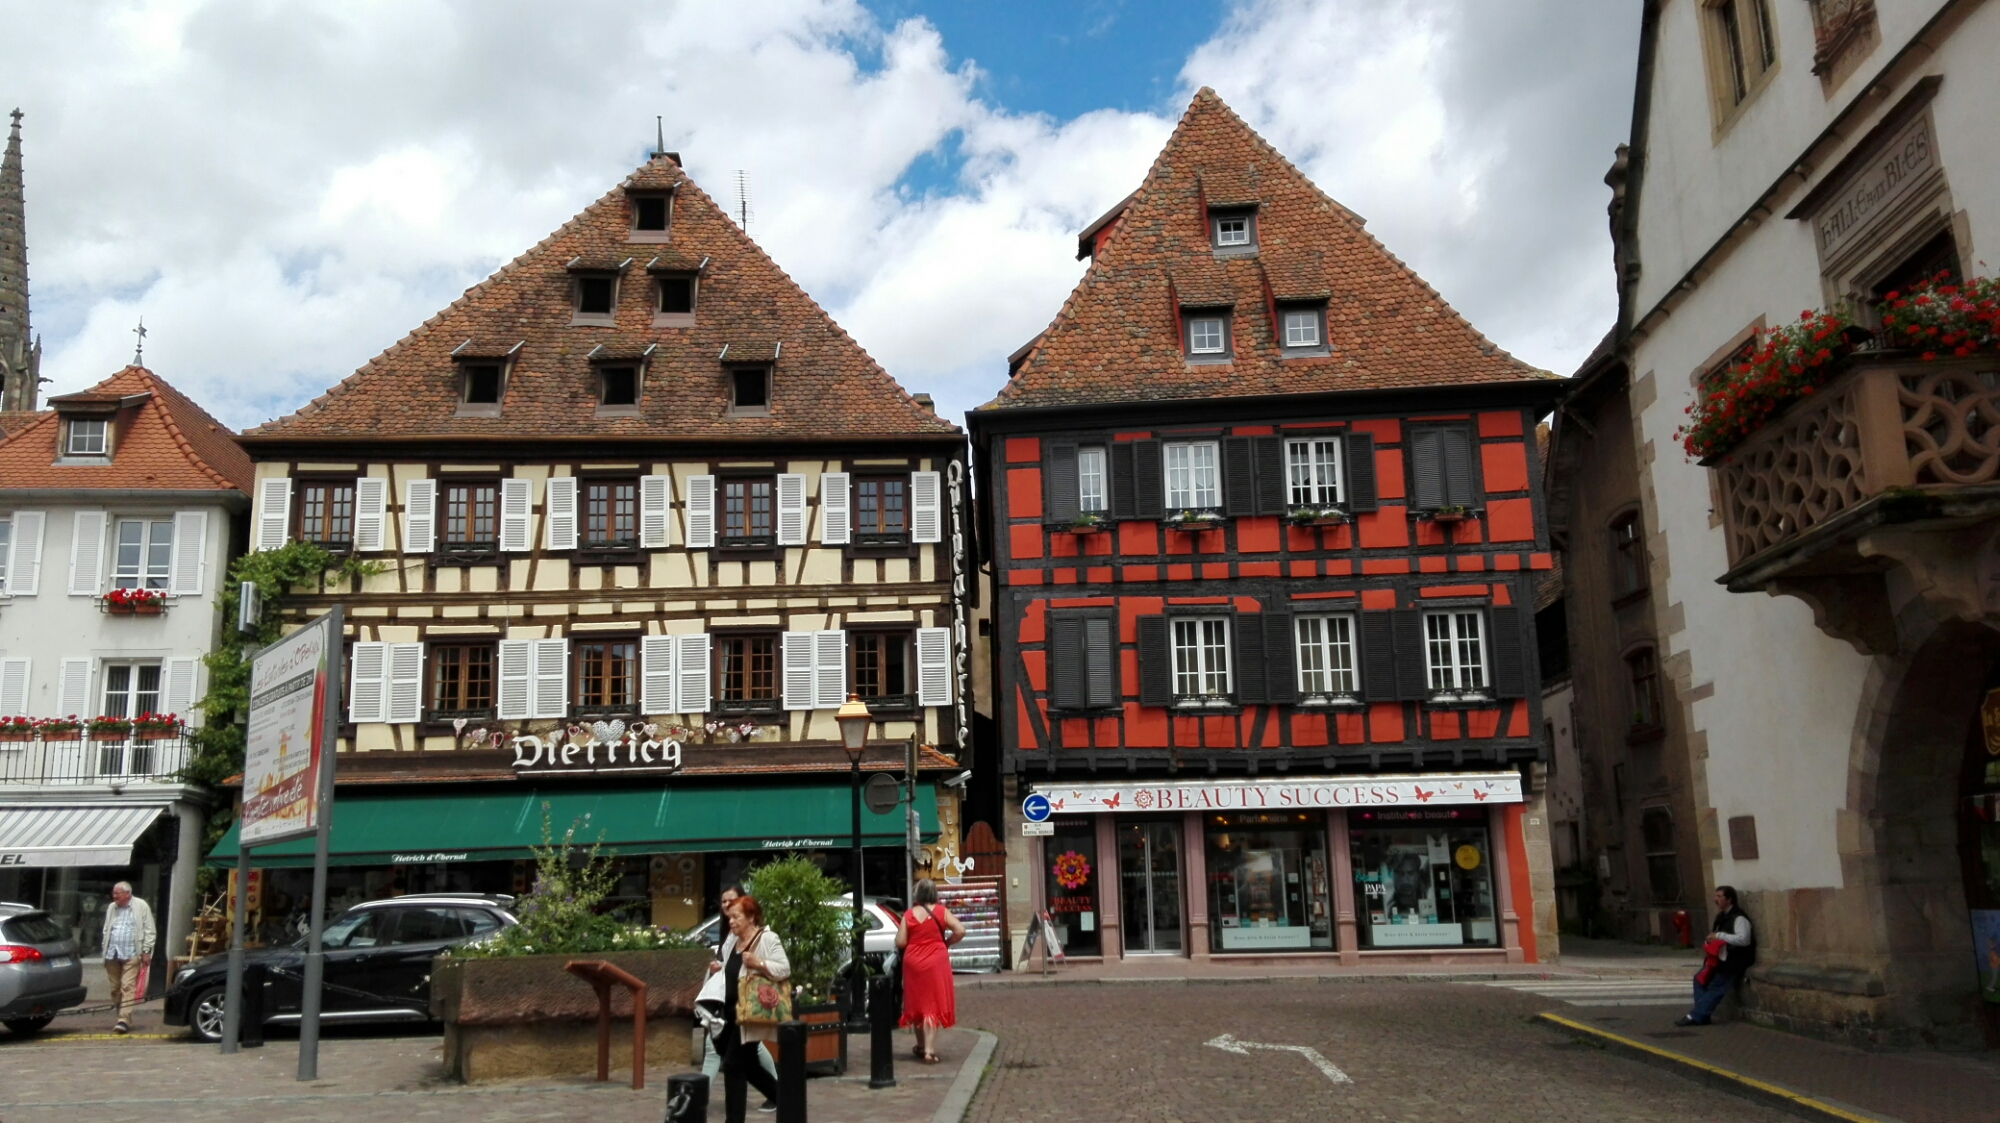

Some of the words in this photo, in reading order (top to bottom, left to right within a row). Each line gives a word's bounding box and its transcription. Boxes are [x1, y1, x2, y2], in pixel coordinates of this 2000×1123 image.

[511, 733, 682, 767] Dietrich
[1157, 786, 1270, 809] BEAUTY
[1279, 785, 1399, 807] SUCCESS
[1377, 811, 1408, 820] Institut
[761, 839, 794, 849] Dietrich
[0, 854, 26, 865] EL
[391, 853, 425, 863] Dietrich
[1365, 884, 1386, 892] PAPA
[1054, 896, 1092, 904] BEAUTY
